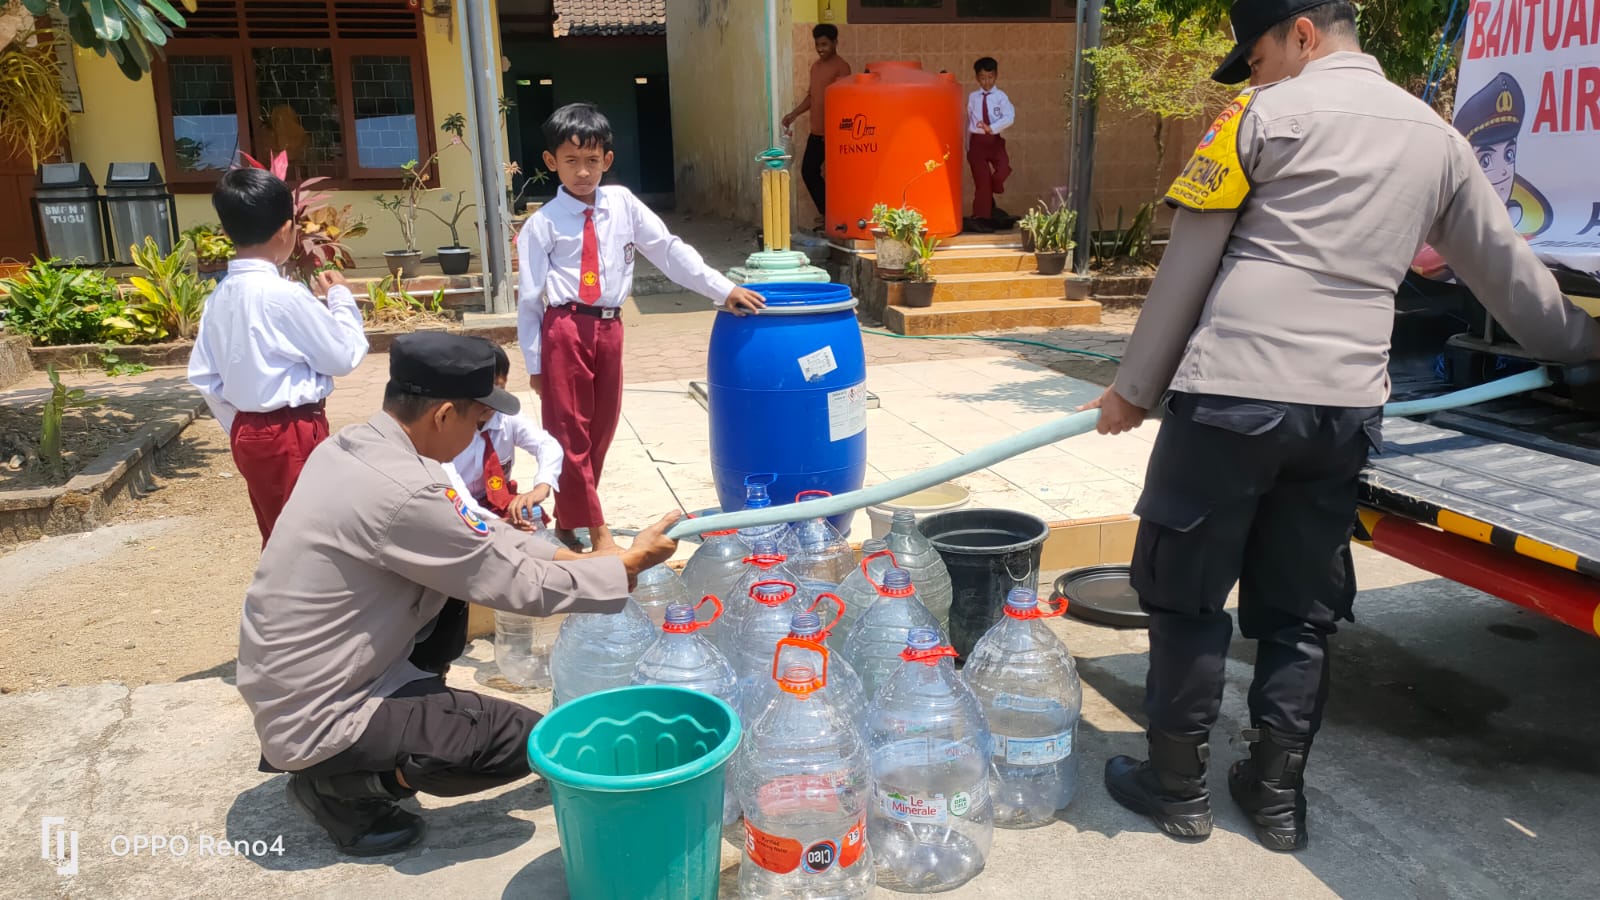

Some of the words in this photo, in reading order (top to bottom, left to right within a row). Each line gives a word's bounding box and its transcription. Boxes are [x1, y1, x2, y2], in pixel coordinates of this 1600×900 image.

[1531, 66, 1600, 134] AIR
[50, 215, 84, 224] TUGU
[892, 800, 937, 815] Minerale
[910, 796, 924, 807] Le
[807, 849, 831, 864] Cleo
